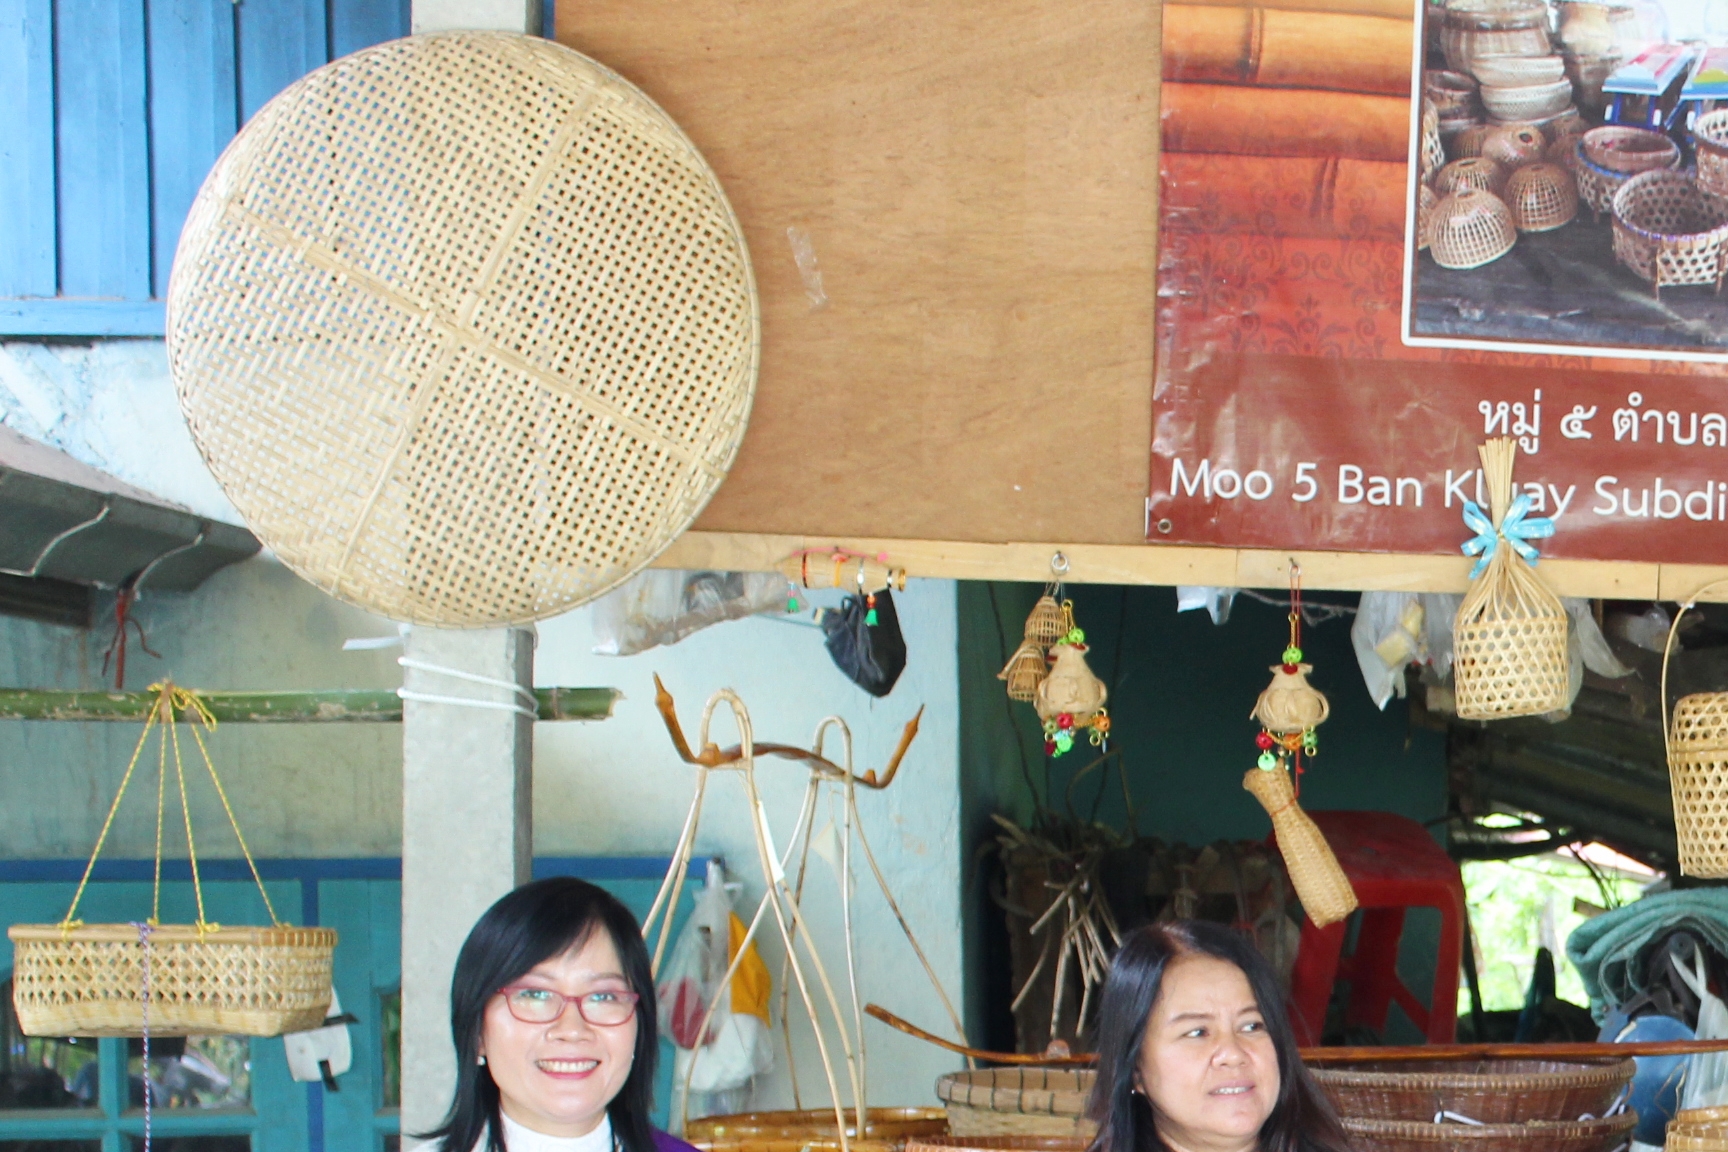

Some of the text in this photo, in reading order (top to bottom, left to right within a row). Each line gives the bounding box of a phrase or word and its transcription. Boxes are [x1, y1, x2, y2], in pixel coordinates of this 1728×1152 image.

[1478, 388, 1541, 455] หมู่
[1560, 405, 1598, 440] ๕
[1170, 458, 1274, 502] Moo
[1292, 461, 1318, 502] 5
[1337, 464, 1428, 508] Ban
[1444, 468, 1577, 521] Klay
